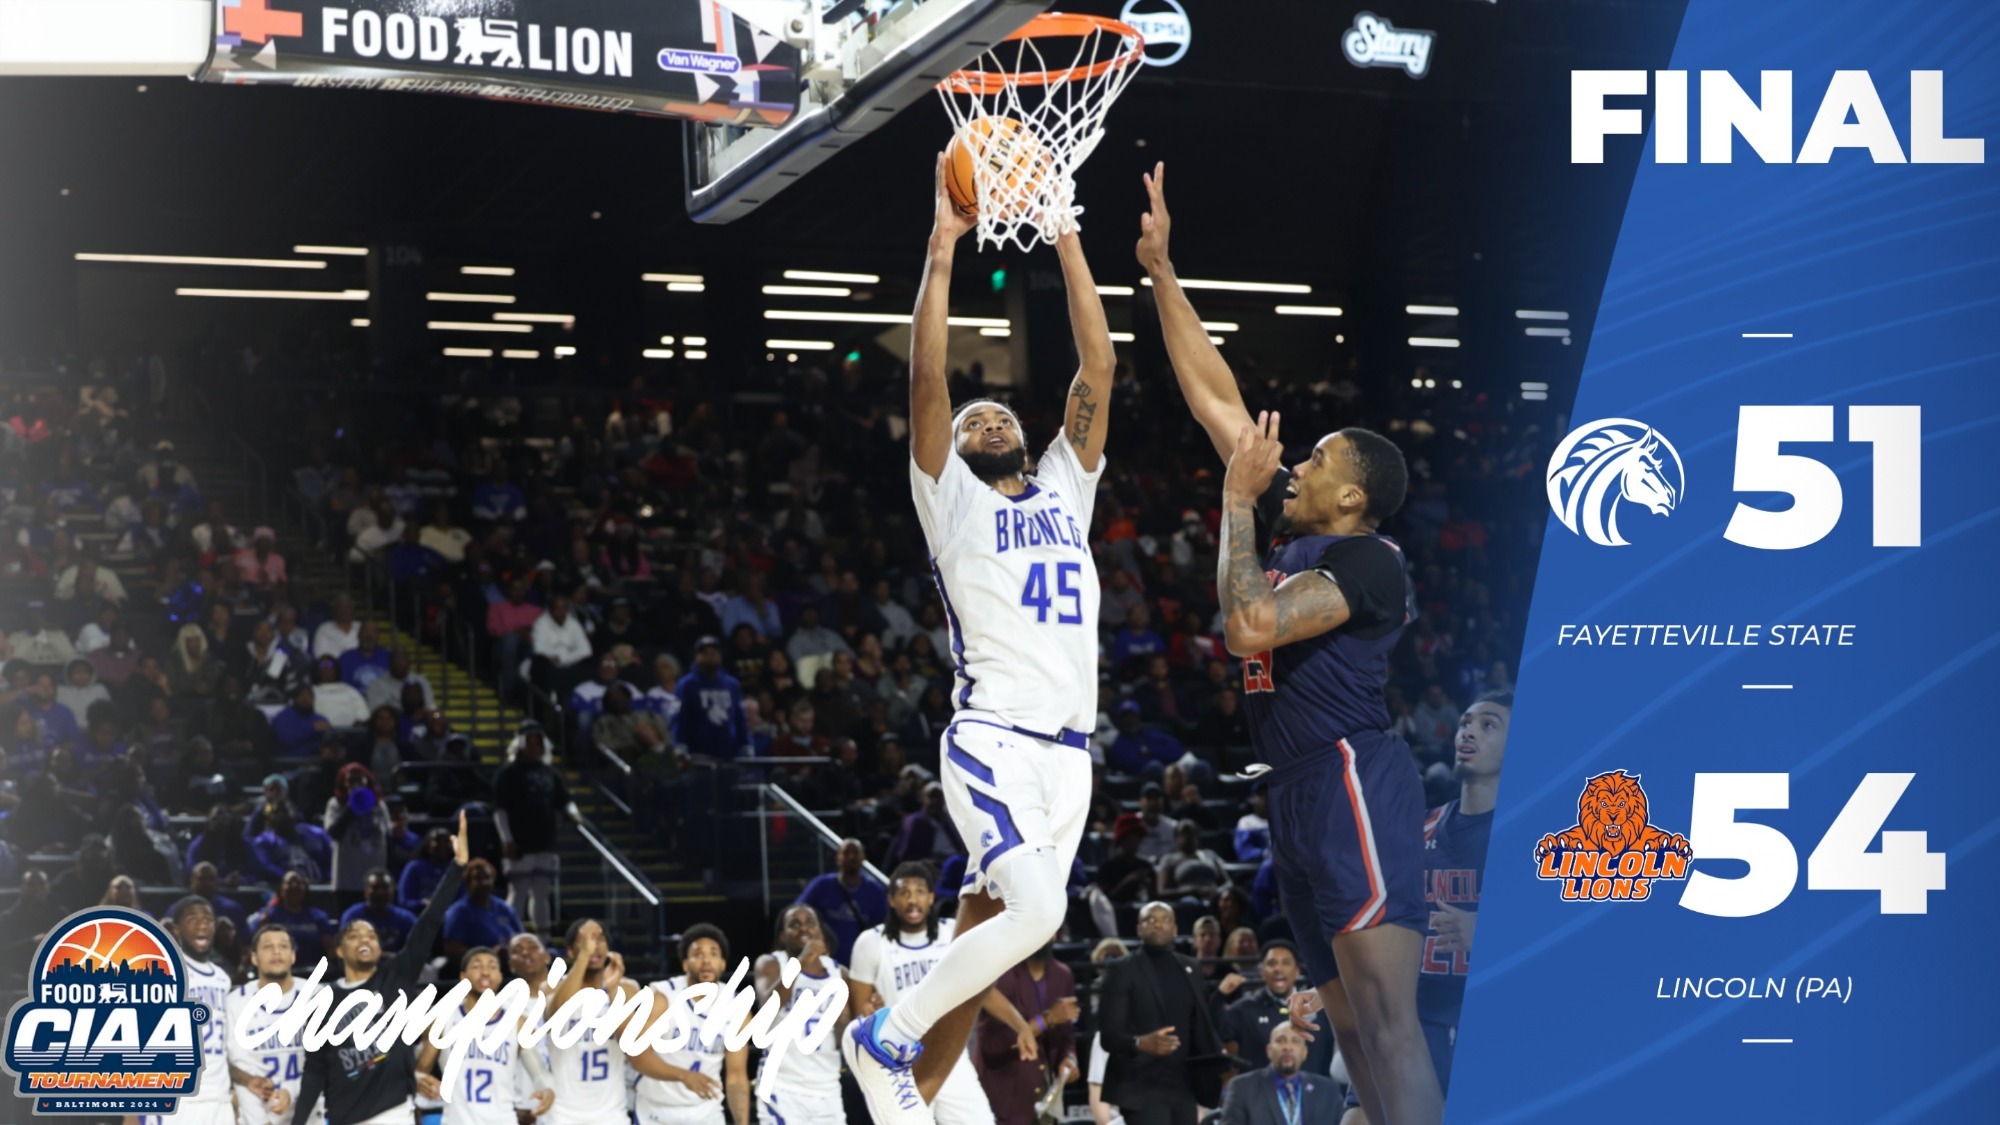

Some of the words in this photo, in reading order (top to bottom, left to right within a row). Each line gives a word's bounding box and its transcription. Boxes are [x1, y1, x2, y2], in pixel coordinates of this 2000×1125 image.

[322, 7, 449, 61] FOOD
[528, 24, 632, 77] LION
[666, 52, 689, 66] Van
[690, 54, 737, 71] Wagner
[995, 507, 1087, 554] BRONCO
[1021, 561, 1083, 625] 45
[1424, 869, 1481, 902] LINCOL
[581, 1048, 609, 1081] 15
[465, 1068, 493, 1103] 12
